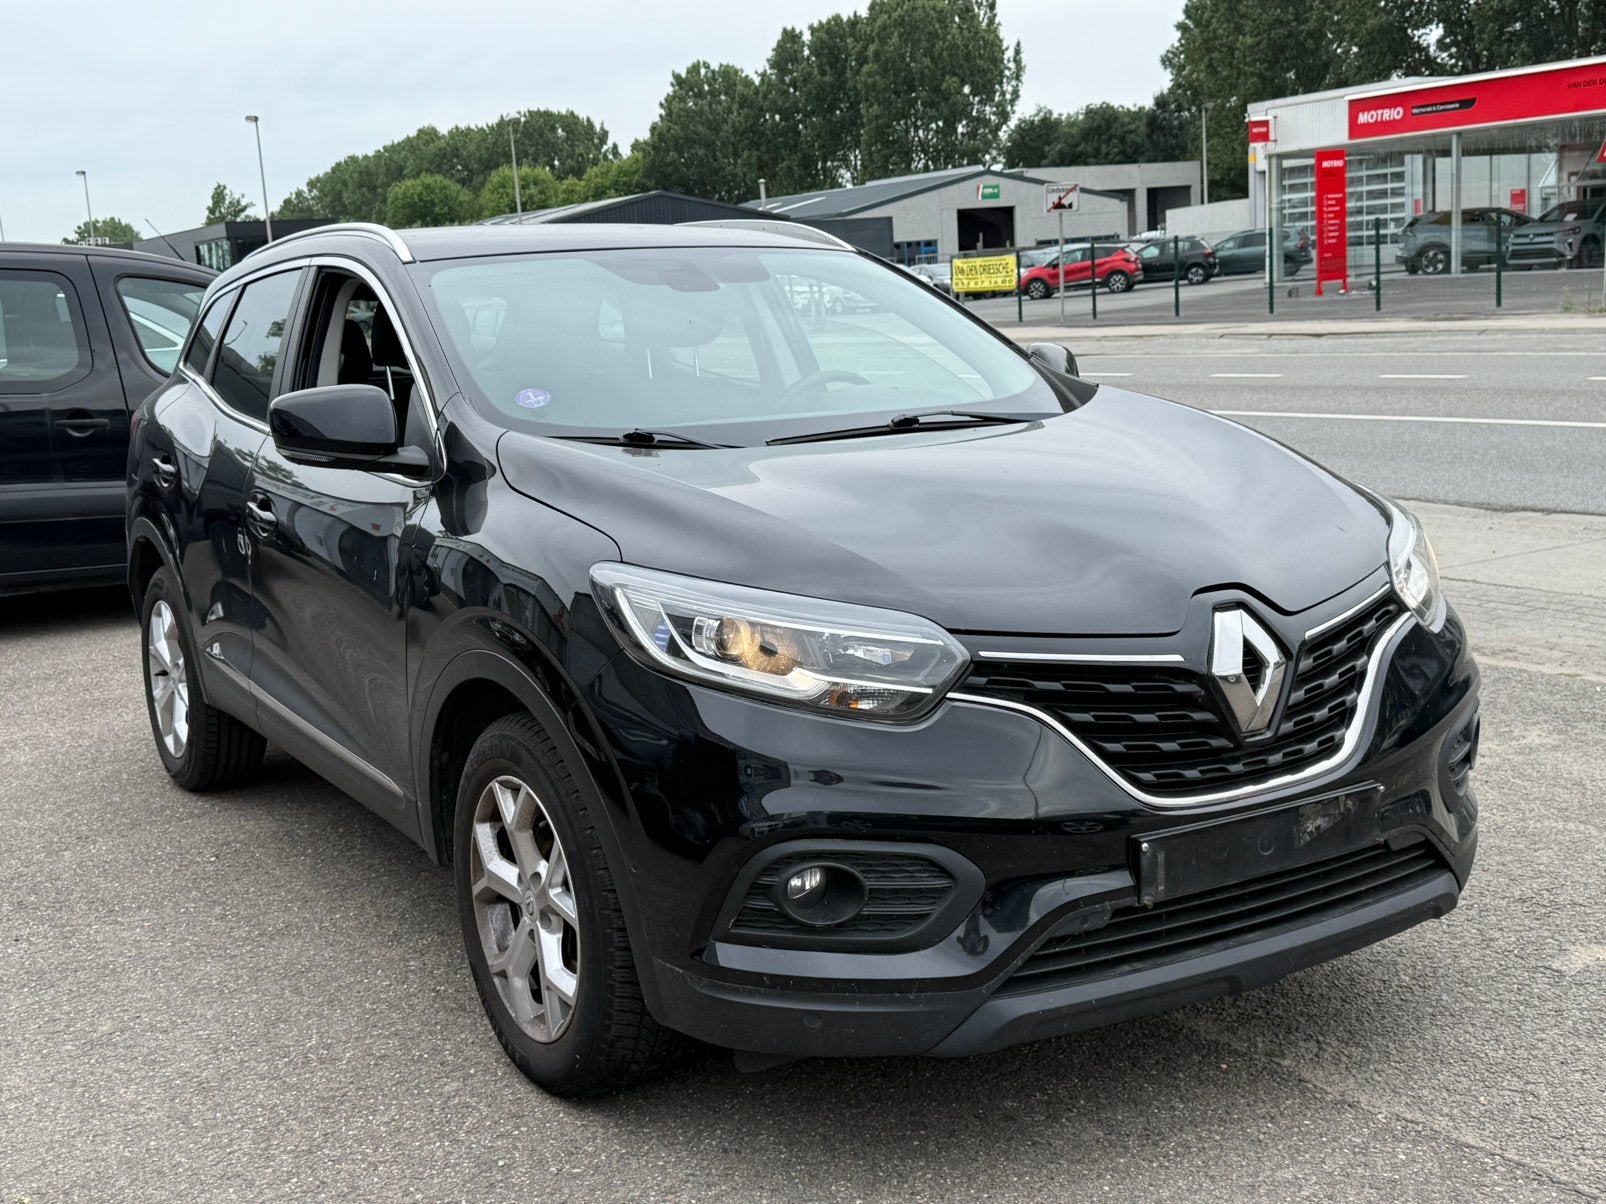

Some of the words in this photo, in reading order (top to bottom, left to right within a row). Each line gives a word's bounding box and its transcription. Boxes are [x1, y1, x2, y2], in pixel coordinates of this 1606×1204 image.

[1358, 107, 1403, 125] MOTRIO
[1322, 160, 1344, 168] MOTRIO
[979, 262, 1009, 275] DRIESSCHE
